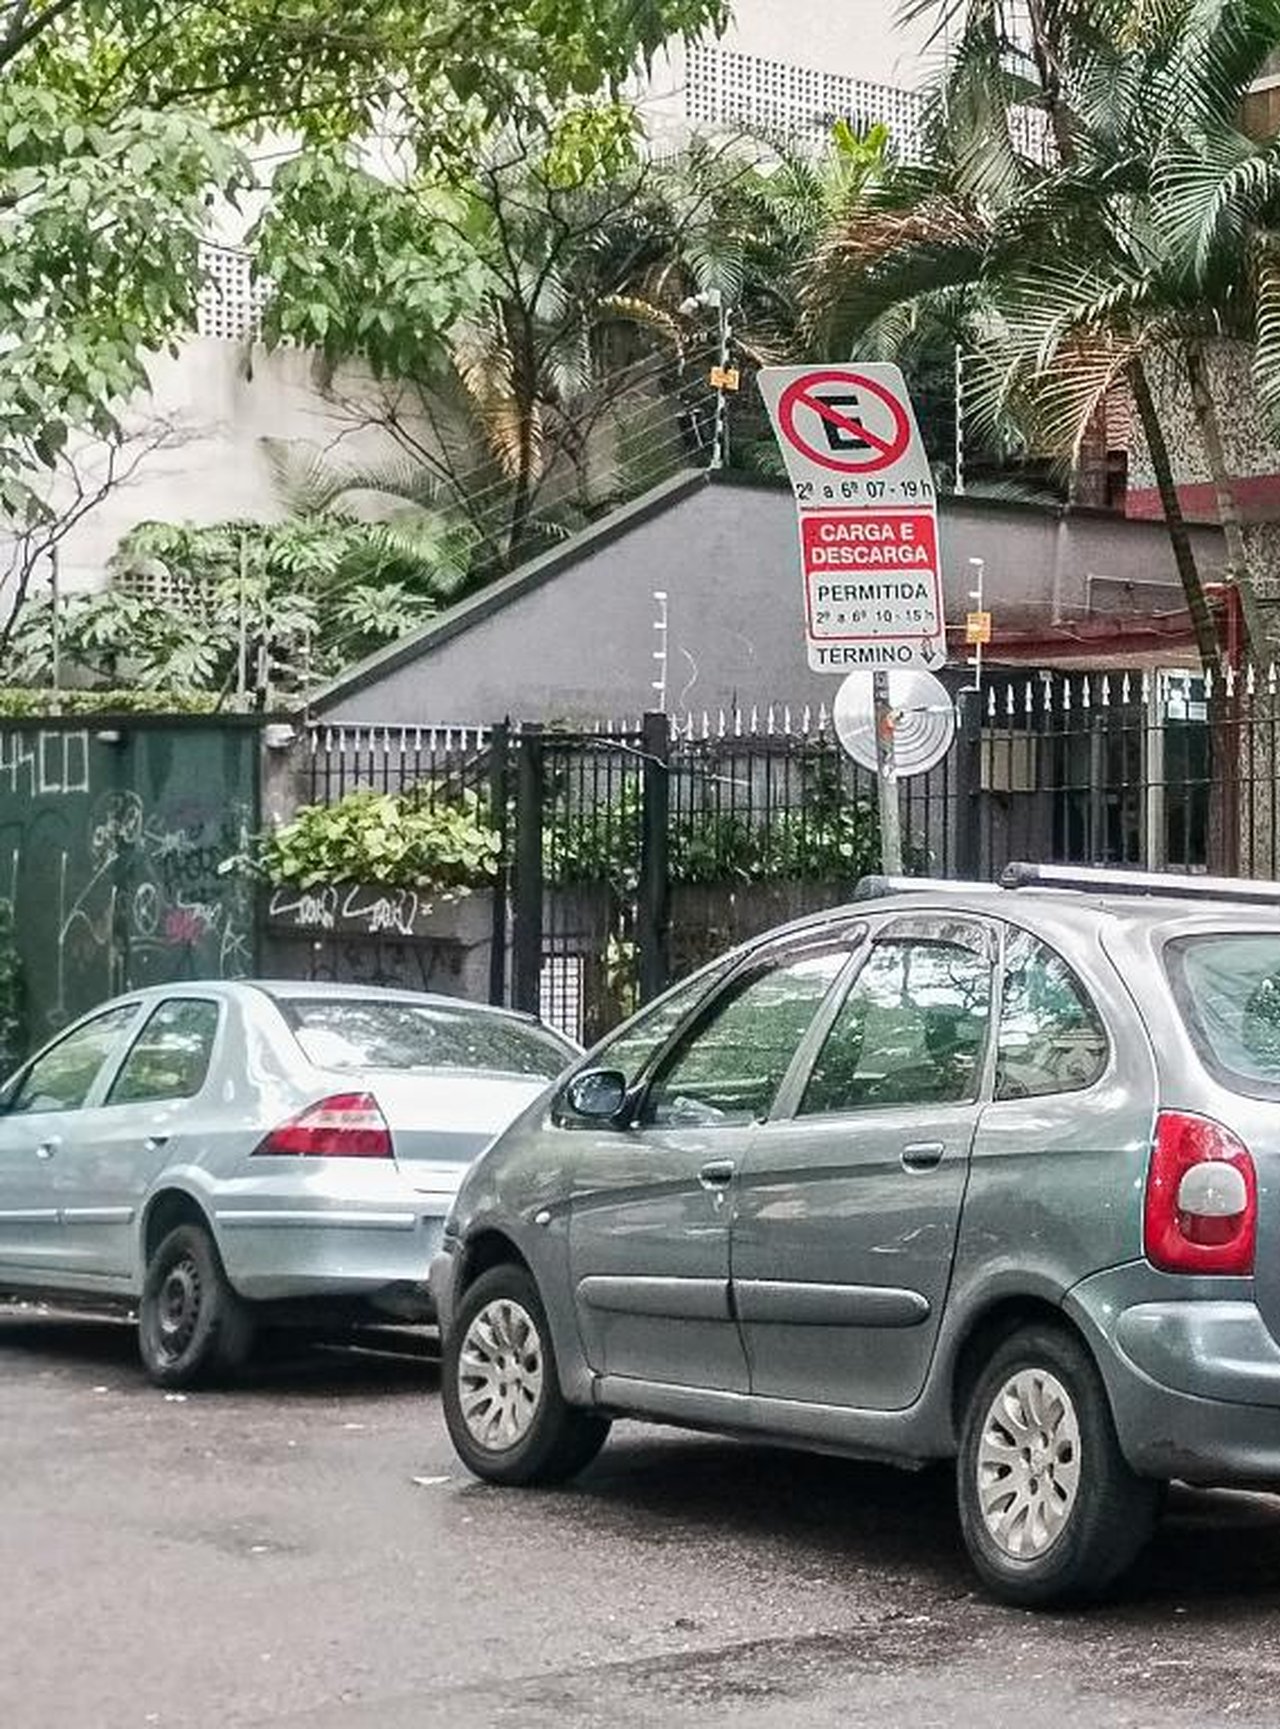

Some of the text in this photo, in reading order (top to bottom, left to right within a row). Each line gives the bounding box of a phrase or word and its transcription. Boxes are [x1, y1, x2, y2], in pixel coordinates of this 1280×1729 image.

[814, 395, 872, 450] E
[824, 485, 834, 498] a
[866, 481, 885, 498] 07
[900, 481, 917, 497] 19
[920, 480, 933, 496] h
[820, 523, 915, 541] CARGA E
[811, 545, 928, 564] DESCARGA
[818, 583, 928, 601] PERMITIDA
[876, 609, 891, 622] 10
